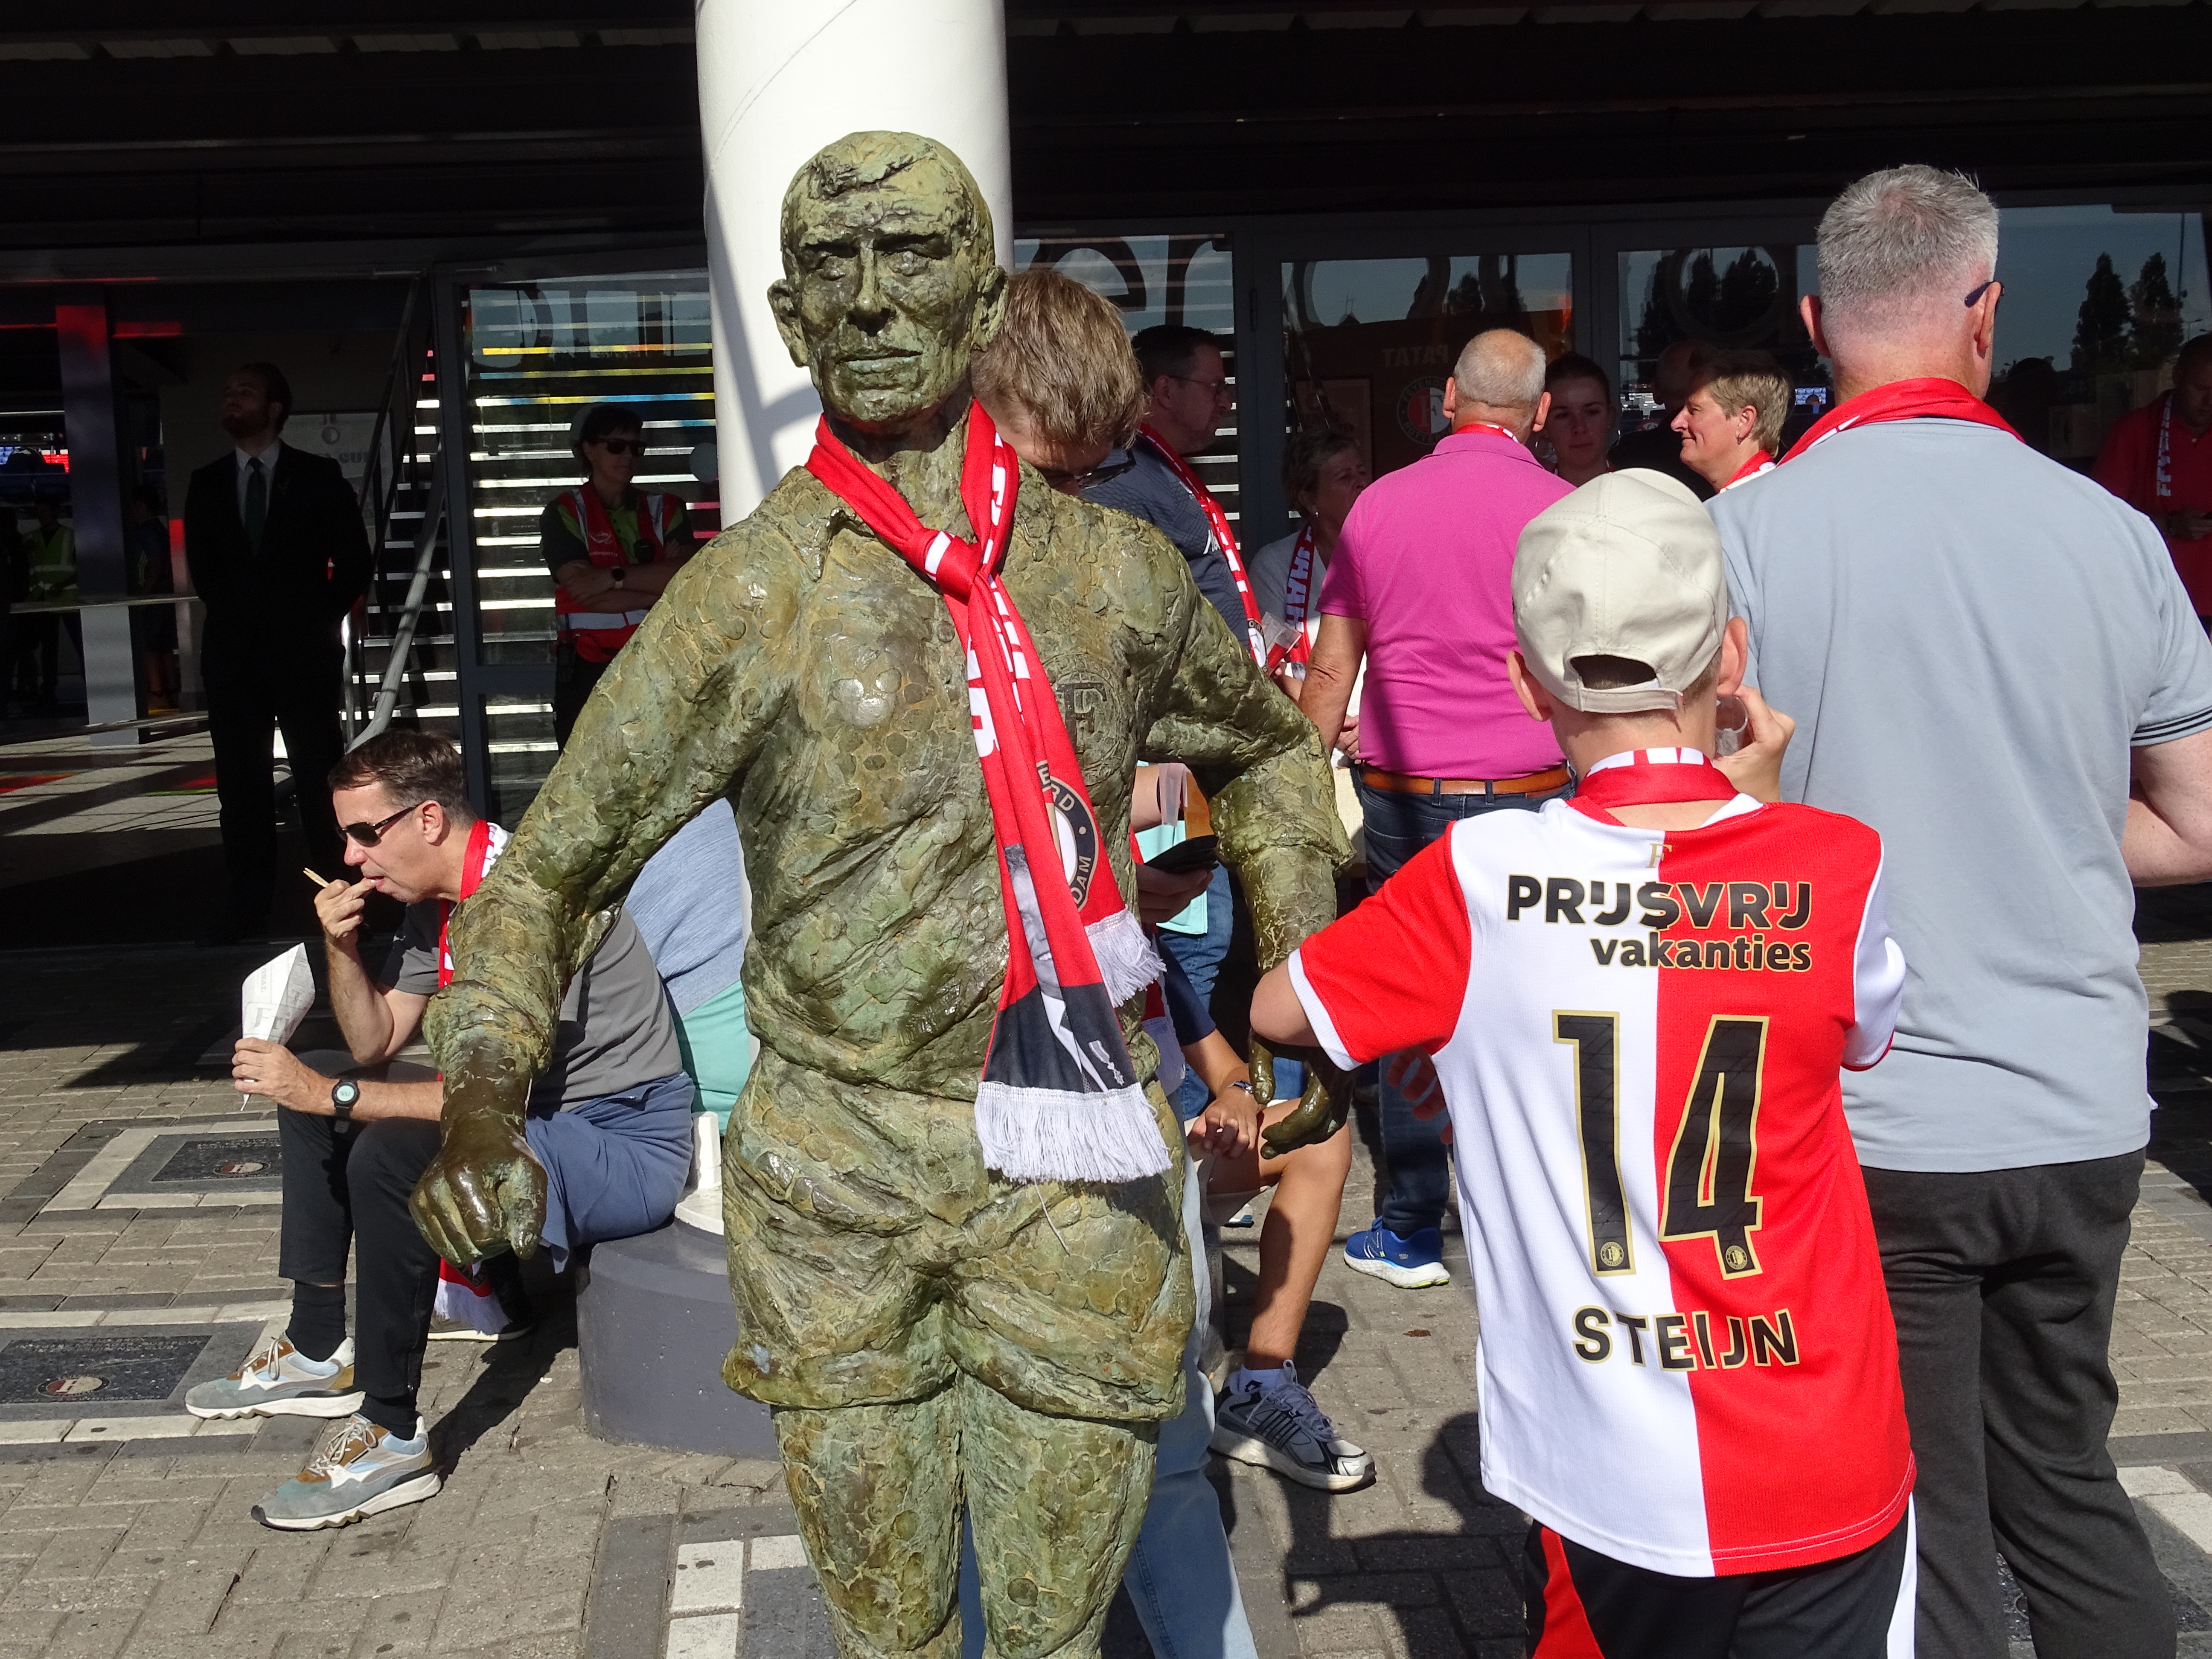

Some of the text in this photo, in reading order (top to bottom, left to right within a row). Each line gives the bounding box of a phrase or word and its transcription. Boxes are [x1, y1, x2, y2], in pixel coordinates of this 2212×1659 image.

[1402, 378, 1446, 402] FEYENOO
[1646, 843, 1673, 868] F
[1506, 874, 1813, 931] PRIJSVRIJ
[1590, 931, 1813, 972] vakanties
[1552, 1010, 1770, 1280] 14
[1572, 1304, 1800, 1372] STEIJN
